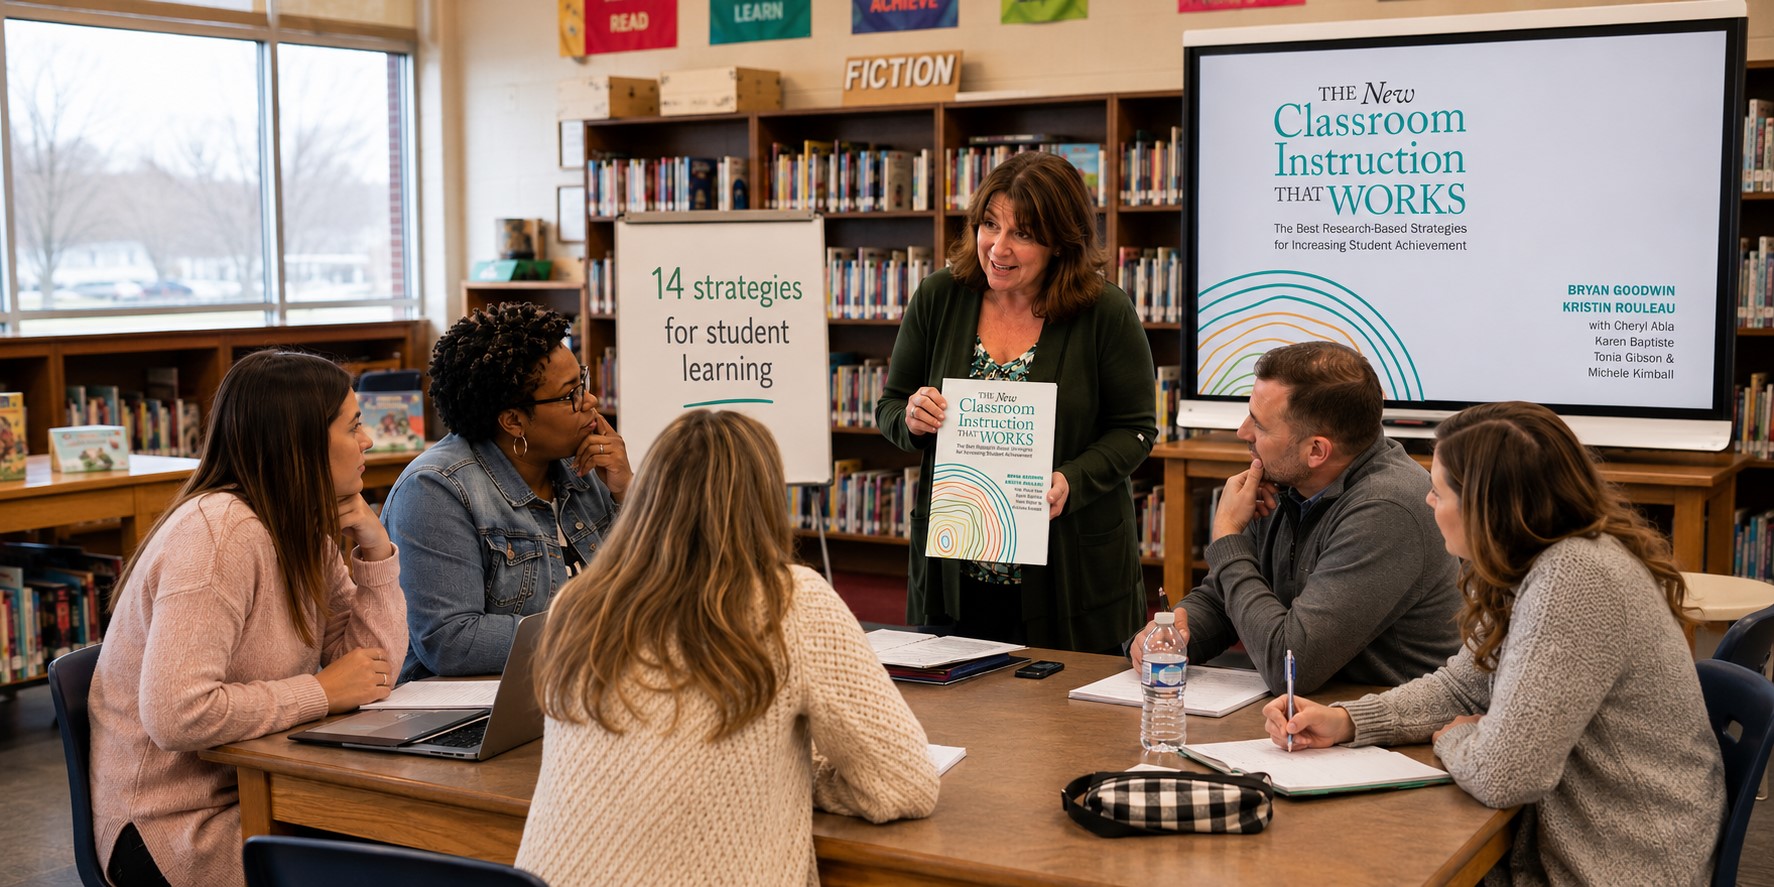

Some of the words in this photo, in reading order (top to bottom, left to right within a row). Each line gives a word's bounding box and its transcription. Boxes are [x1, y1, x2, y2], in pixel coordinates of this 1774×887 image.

[734, 1, 784, 23] LEARN
[869, 0, 941, 14] ACHIEVE
[610, 11, 649, 33] READ
[845, 54, 955, 90] FICTION
[1318, 85, 1357, 101] THE
[1360, 81, 1415, 104] New
[1274, 102, 1466, 138] Classroom
[1274, 141, 1466, 176] Instruction
[1274, 186, 1324, 202] THAT
[1326, 183, 1466, 215] WORKS
[1274, 223, 1293, 234] The
[1296, 223, 1320, 234] Best
[1322, 223, 1408, 234] Research-Based
[1410, 222, 1468, 236] Strategies
[1274, 239, 1289, 250] for
[1291, 239, 1347, 252] Increasing
[1349, 239, 1393, 250] Student
[1395, 239, 1467, 250] Achievement
[651, 266, 685, 300] 14
[693, 274, 803, 308] strategies
[1567, 284, 1610, 296] BRYAN
[1613, 285, 1676, 296] GOODWIN
[1562, 301, 1612, 313] KRISTIN
[1615, 302, 1676, 314] ROULEAU
[664, 316, 699, 344] for
[706, 316, 790, 345] student
[1588, 320, 1611, 330] with
[1614, 320, 1648, 333] Cheryl
[1650, 321, 1675, 331] Abla
[1595, 336, 1626, 347] Karen
[1630, 336, 1675, 349] Baptiste
[1594, 351, 1622, 362] Tonia
[1625, 352, 1662, 363] Gibson
[1665, 353, 1675, 364] &
[682, 353, 774, 389] learning
[1588, 367, 1629, 378] Michele
[1633, 368, 1674, 379] Kimball
[978, 391, 995, 400] THE
[959, 398, 1035, 415] Classroom
[958, 413, 1034, 430] Instruction
[957, 430, 979, 438] THAT
[979, 431, 1034, 446] WORKS
